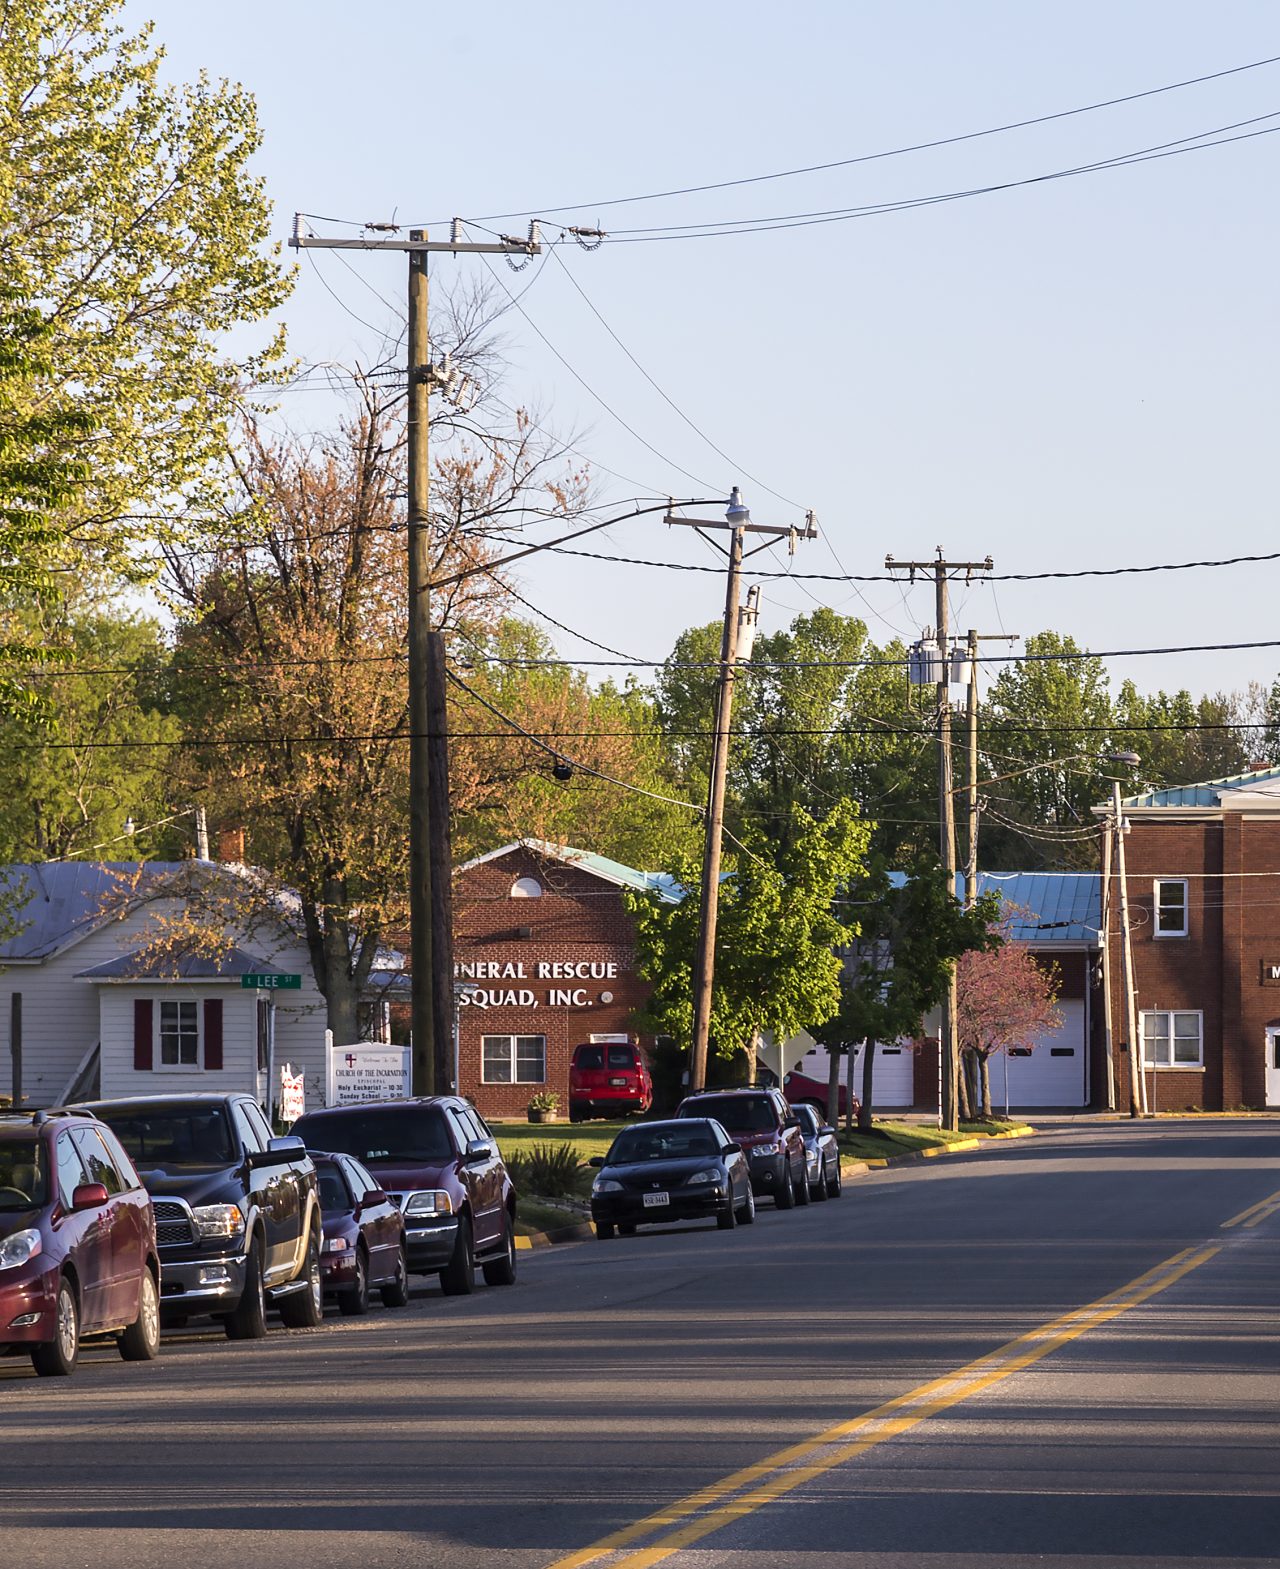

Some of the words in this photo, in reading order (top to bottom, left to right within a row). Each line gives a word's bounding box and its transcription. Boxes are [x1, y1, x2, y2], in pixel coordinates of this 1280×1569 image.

[453, 962, 528, 979] INERAL
[538, 962, 617, 979] RESCUE
[257, 975, 279, 987] LEE
[459, 989, 539, 1009] SQUAD,
[549, 989, 593, 1006] INC.
[335, 1069, 356, 1077] CHURCH
[356, 1069, 363, 1077] OF
[365, 1069, 375, 1077] THE
[376, 1069, 408, 1077] INCARNATION
